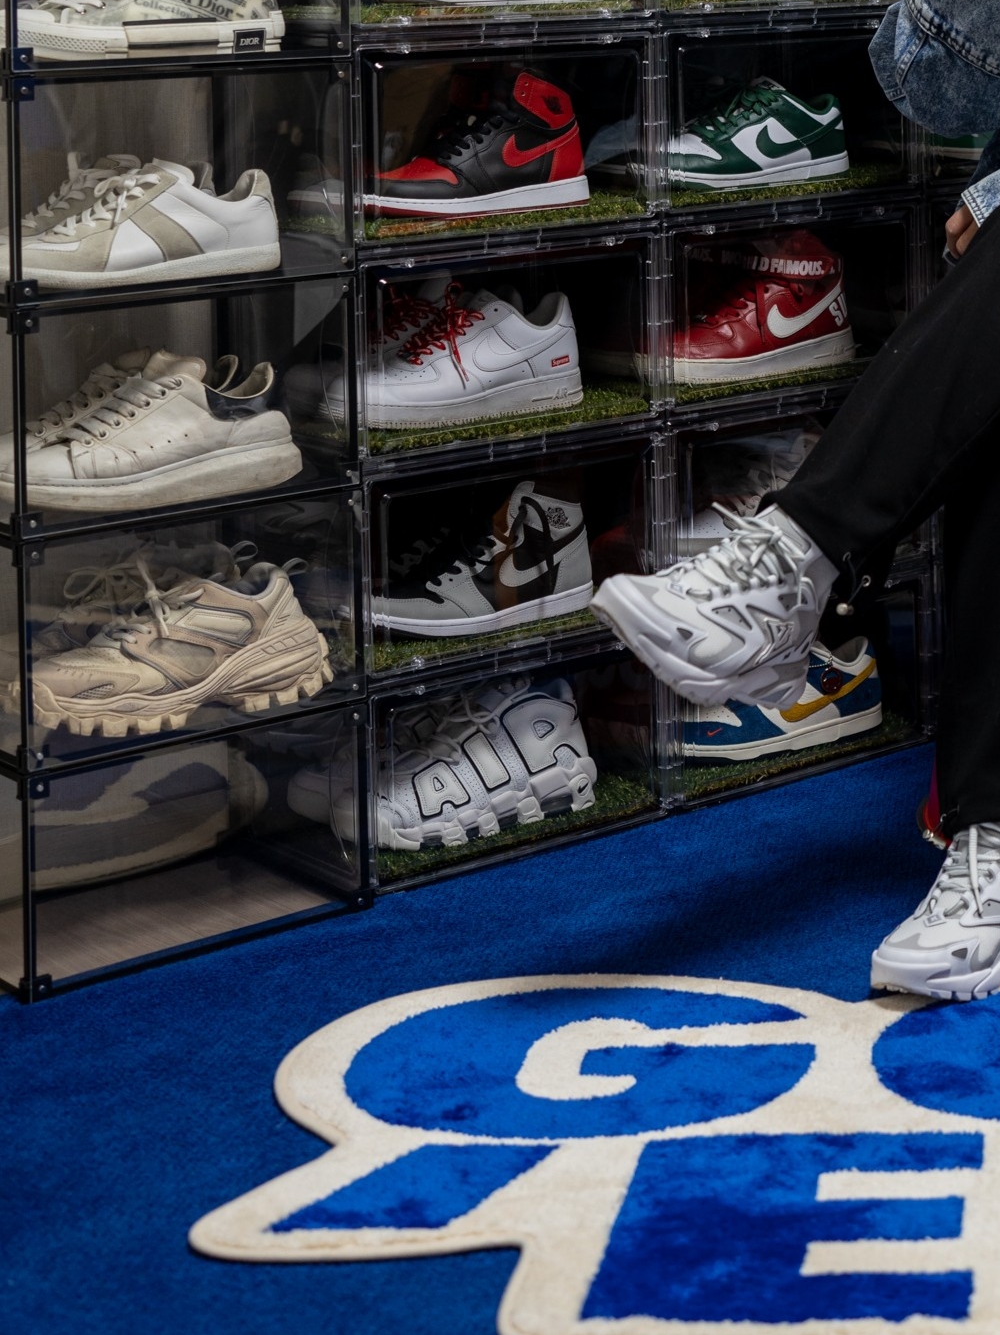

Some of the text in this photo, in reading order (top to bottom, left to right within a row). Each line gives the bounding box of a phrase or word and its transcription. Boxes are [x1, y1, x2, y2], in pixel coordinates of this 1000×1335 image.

[239, 37, 260, 46] DIOR
[769, 257, 825, 277] FAMOUS.
[552, 355, 569, 367] Supreme
[412, 693, 583, 819] AIR
